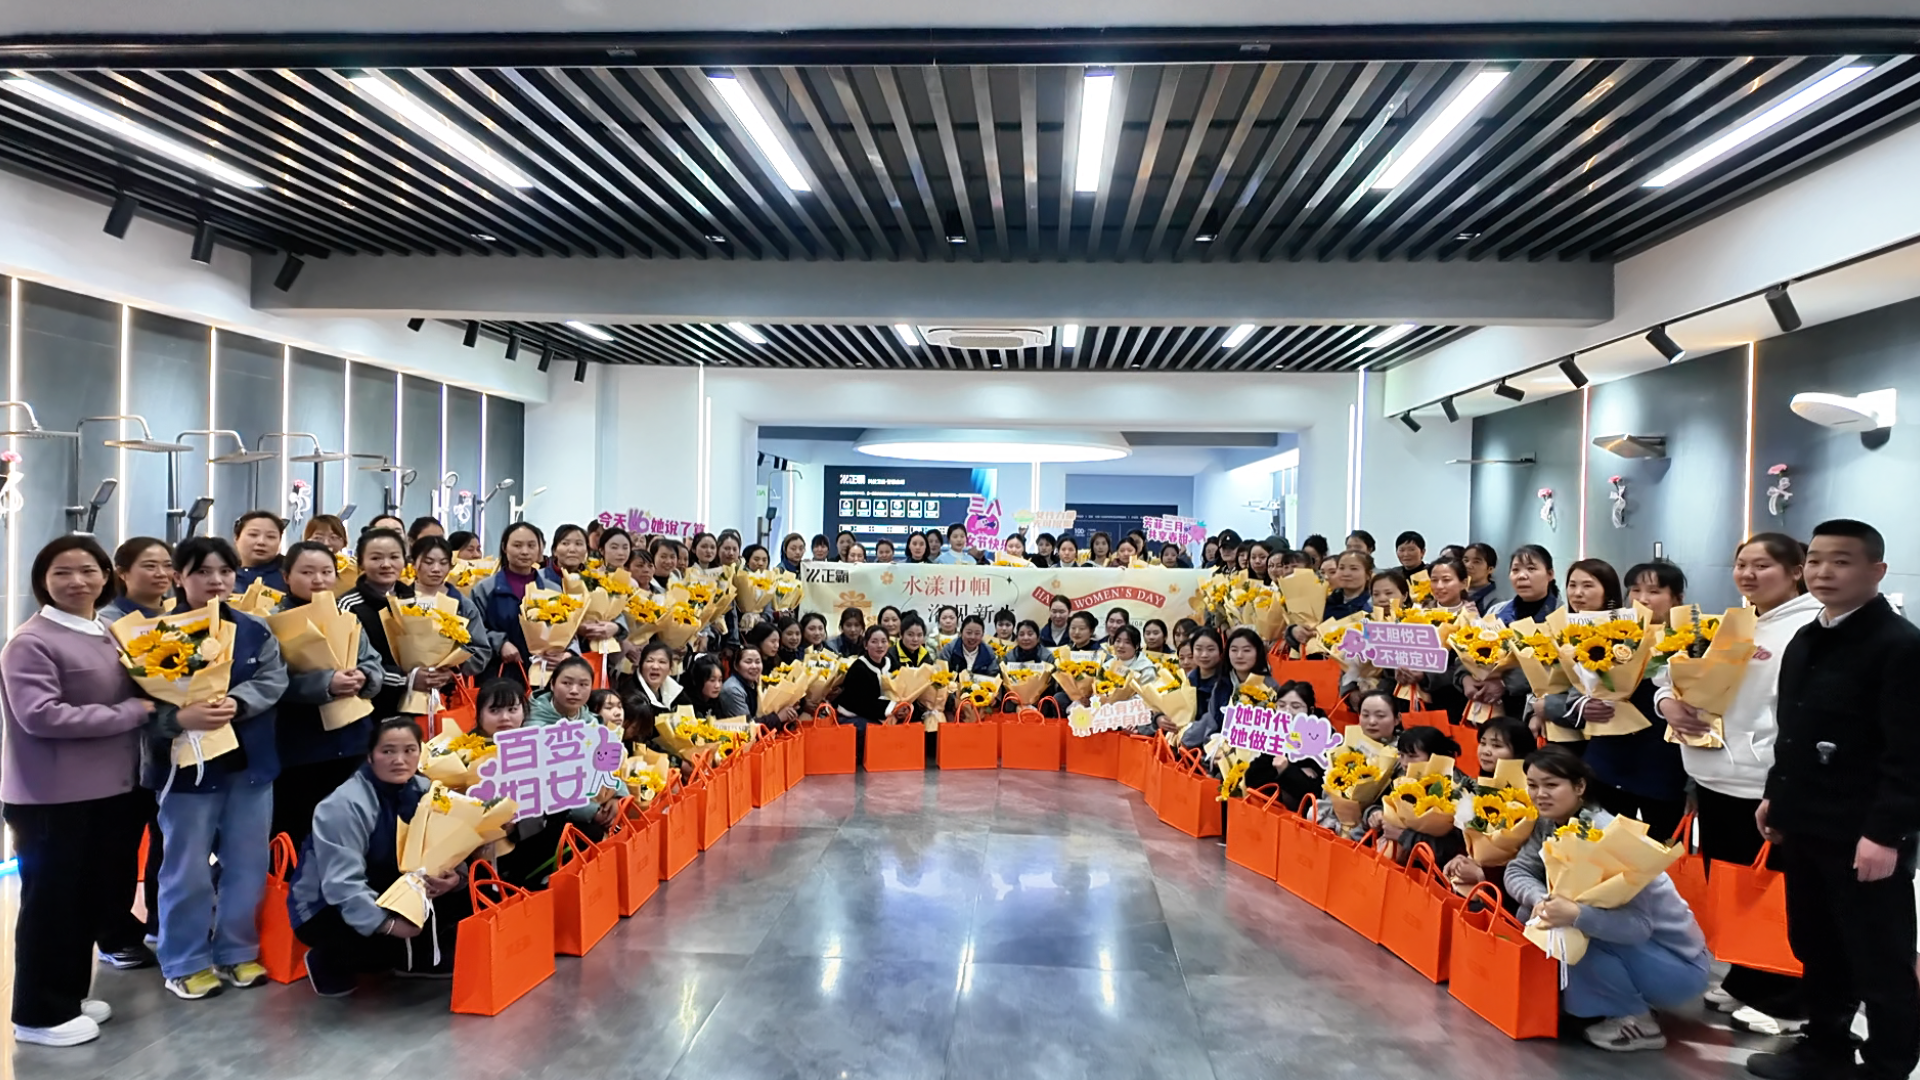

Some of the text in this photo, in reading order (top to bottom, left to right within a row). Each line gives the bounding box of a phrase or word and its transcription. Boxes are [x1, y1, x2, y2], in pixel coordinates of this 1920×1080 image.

[970, 497, 1002, 517] 三八
[598, 511, 706, 536] 今天 她说了算
[903, 575, 991, 597] 水漾巾帼
[1074, 588, 1133, 609] WOMEN'S
[1137, 589, 1164, 608] DAY
[1371, 627, 1431, 646] 大胆悦己
[1380, 649, 1440, 669] 不被定义
[1235, 704, 1291, 734] 她时代
[496, 721, 587, 775] 百变
[1229, 725, 1287, 756] 她做主
[498, 765, 590, 821] 妇女
